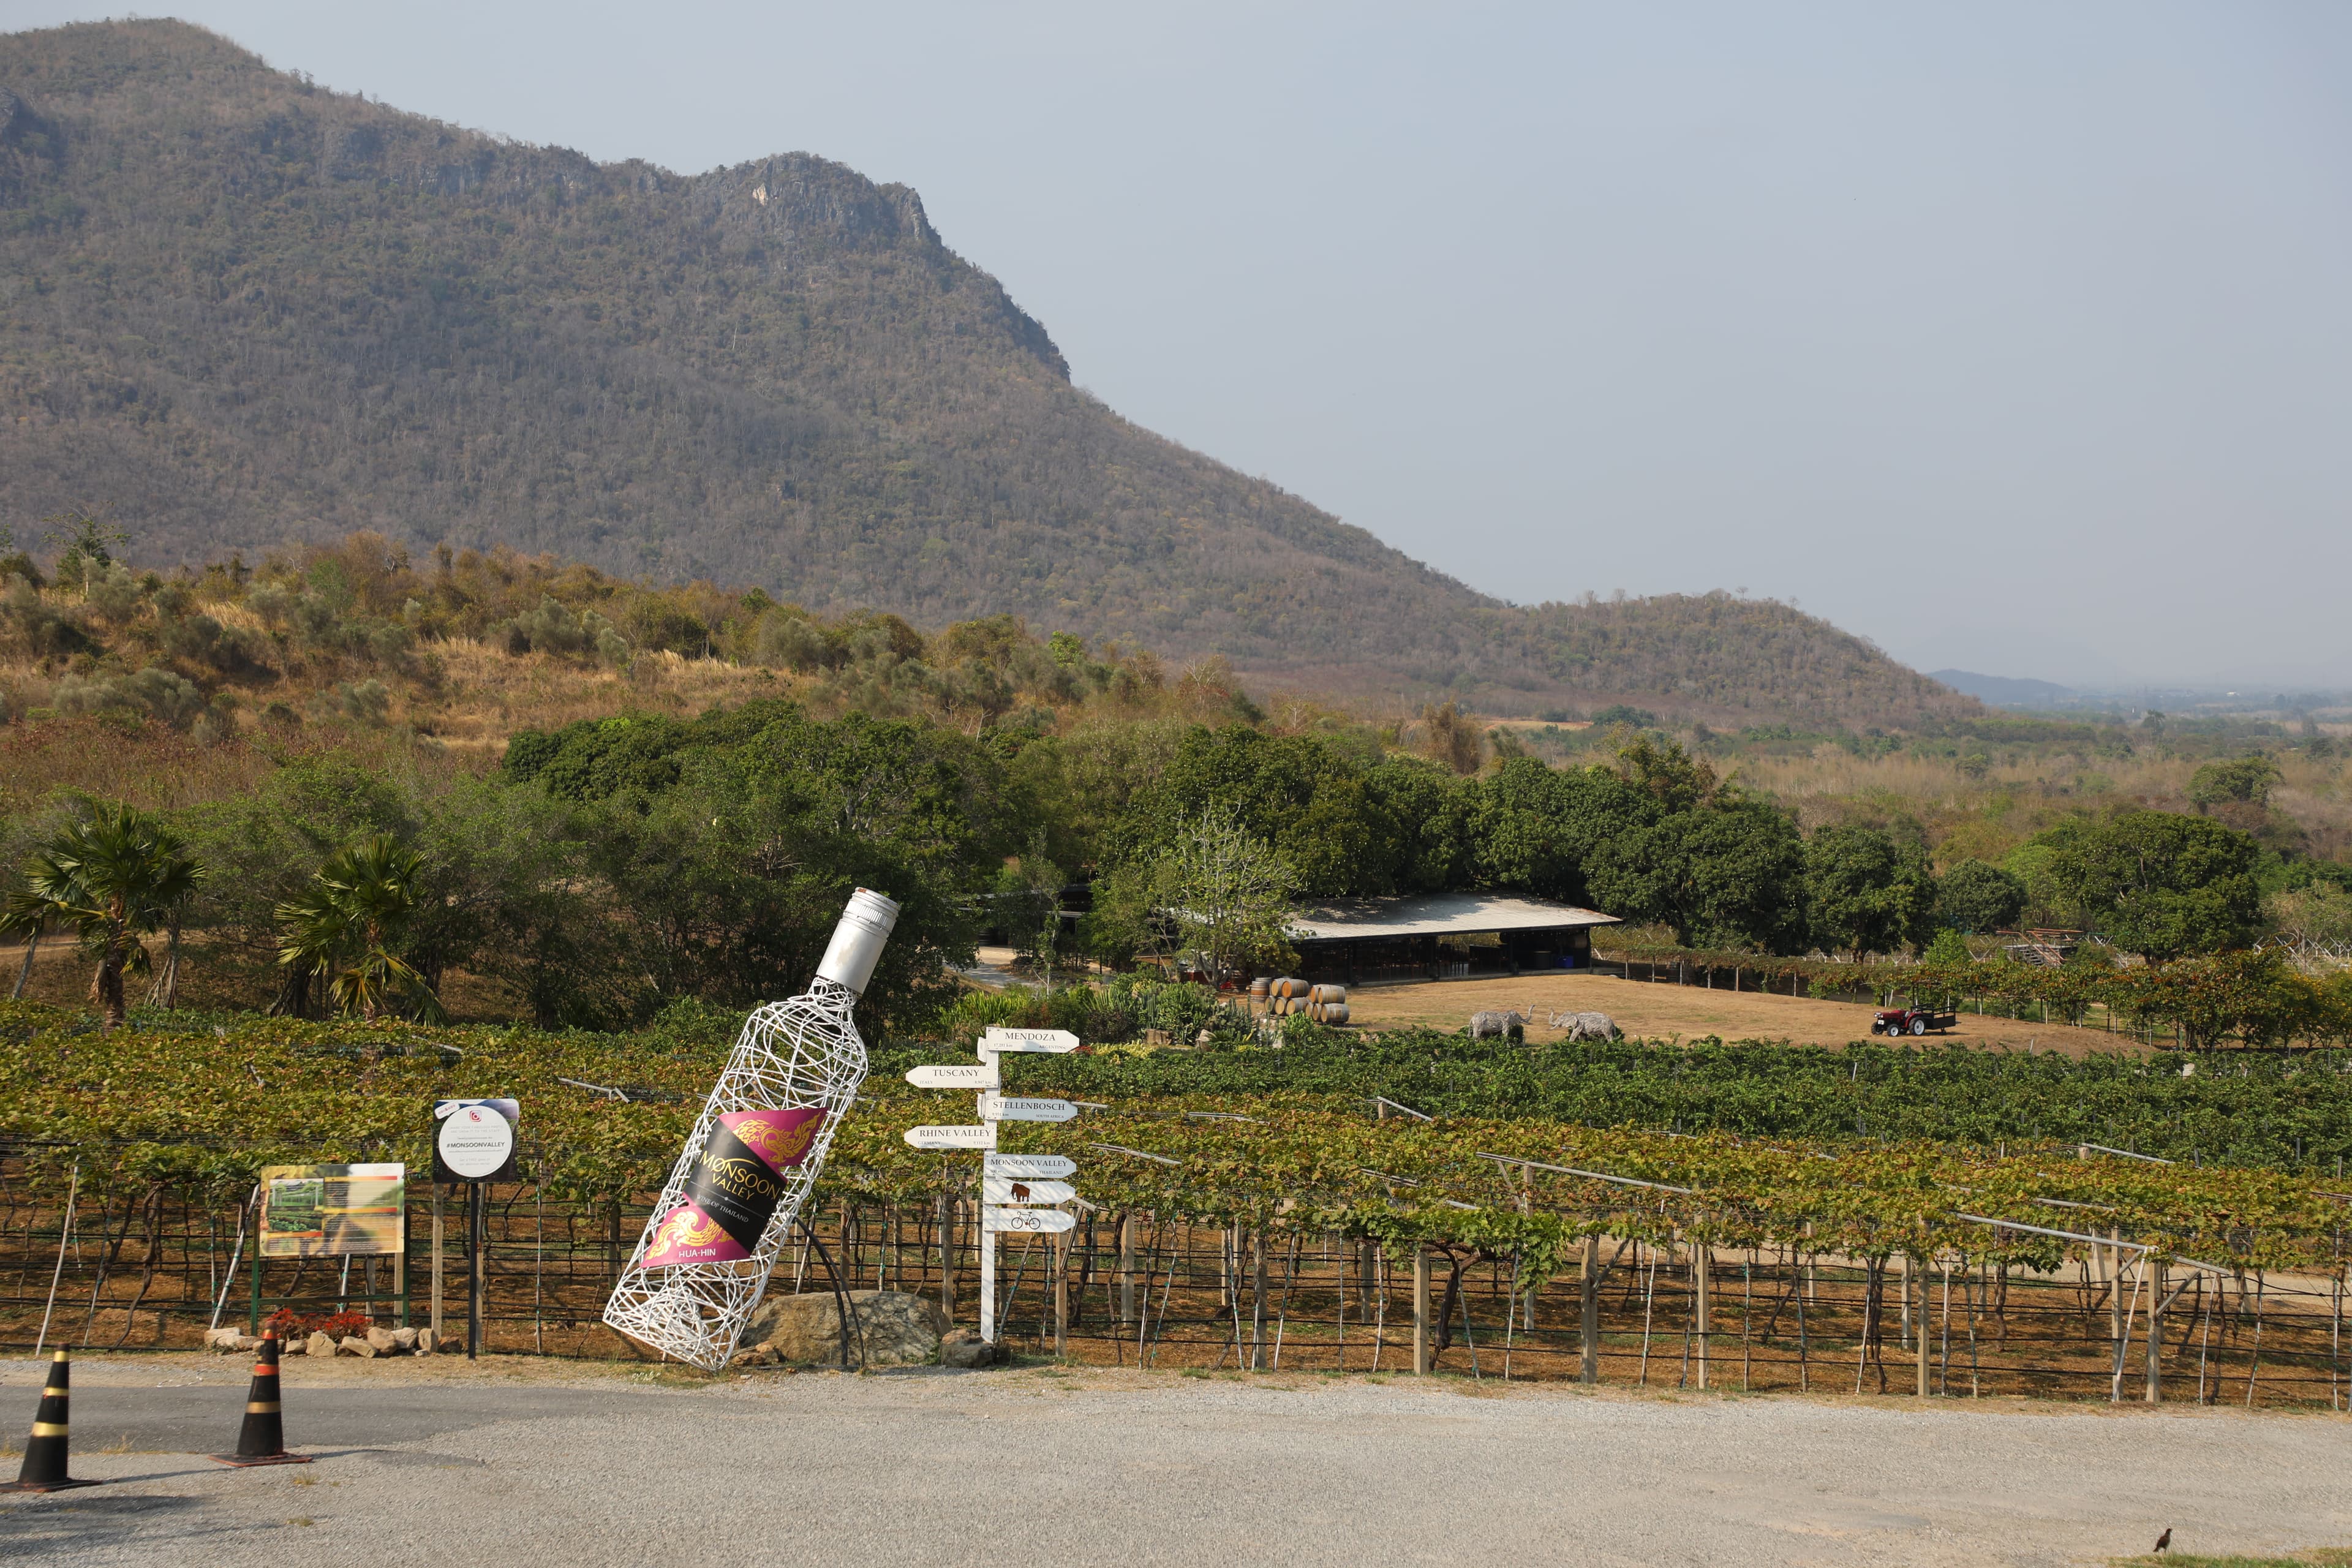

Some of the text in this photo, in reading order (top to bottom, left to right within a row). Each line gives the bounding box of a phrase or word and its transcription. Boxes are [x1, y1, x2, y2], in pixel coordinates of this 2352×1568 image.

[1005, 1032, 1055, 1041] MENDOZA
[993, 1101, 1065, 1110] STELLENBOSCH
[699, 1150, 781, 1200] MONSOON
[712, 1173, 755, 1200] VALLEY
[696, 1194, 749, 1223] WINE OF THAILAND
[679, 1248, 716, 1258] HUA-HIN
